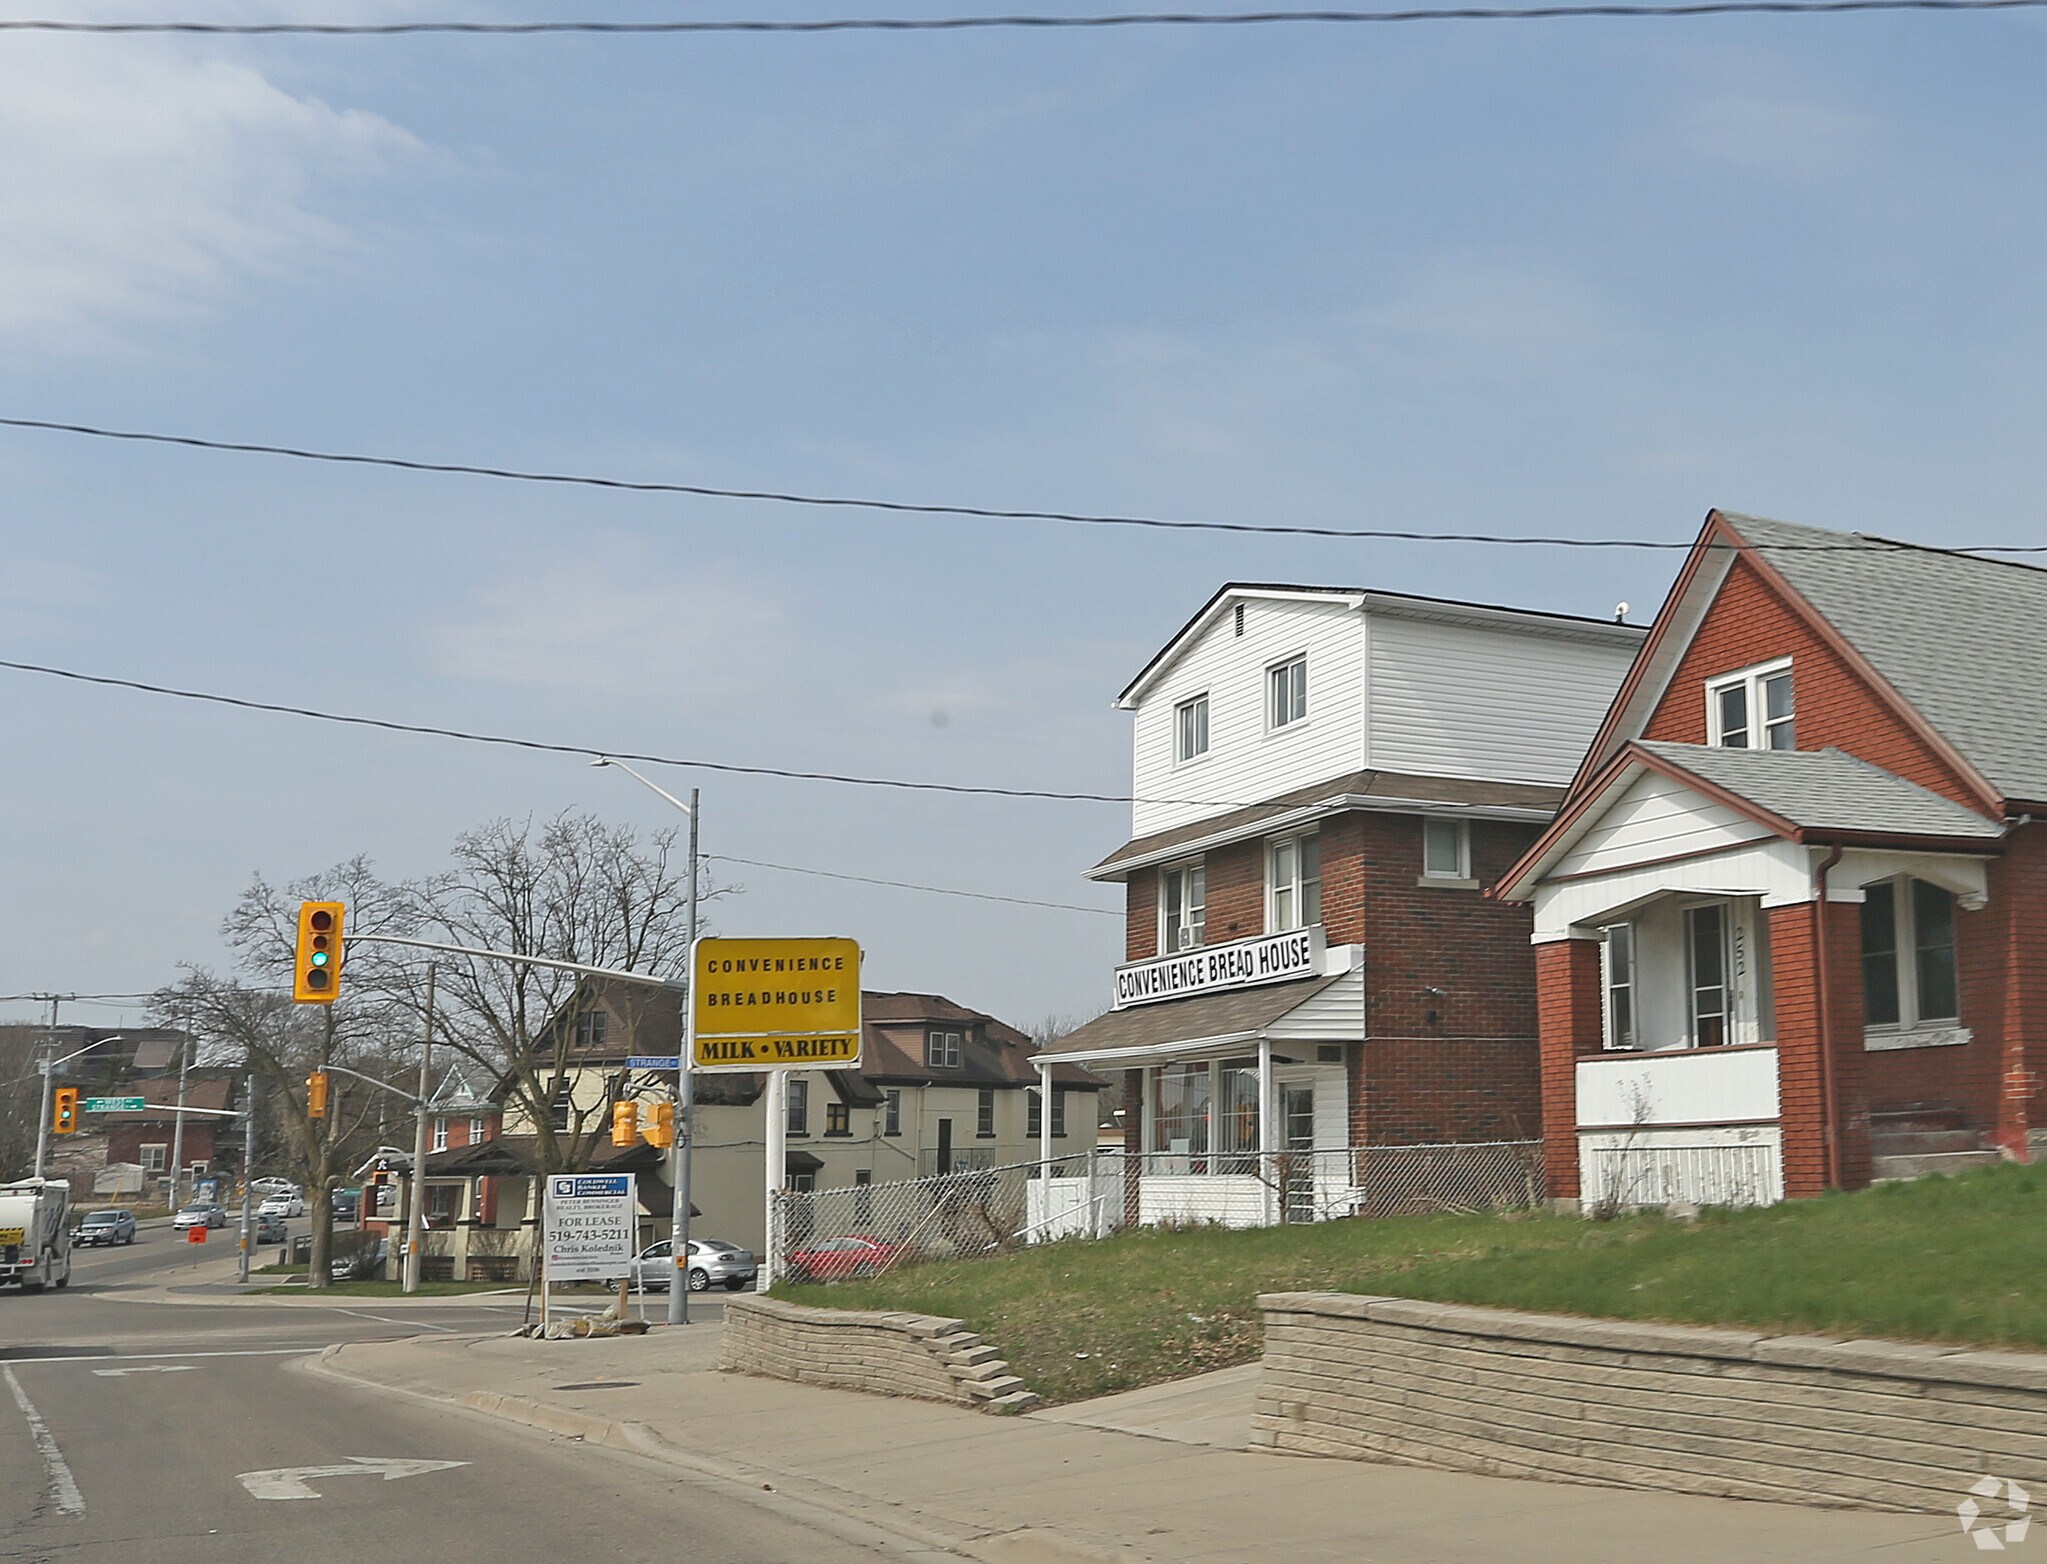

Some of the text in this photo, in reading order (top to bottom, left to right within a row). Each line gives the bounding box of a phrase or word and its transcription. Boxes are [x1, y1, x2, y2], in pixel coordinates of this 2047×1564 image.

[708, 957, 844, 973] CONVENIENCE
[1118, 936, 1310, 999] CONVENIENCE BREAD HOUSE
[708, 990, 836, 1006] BREADHOUSE
[701, 1038, 852, 1060] MILK VARIETY
[629, 1058, 671, 1067] STRANGE
[558, 1216, 622, 1227] FOR LEASE
[549, 1229, 629, 1242] 519-743-5211
[553, 1244, 624, 1253] Chris Kolednik
